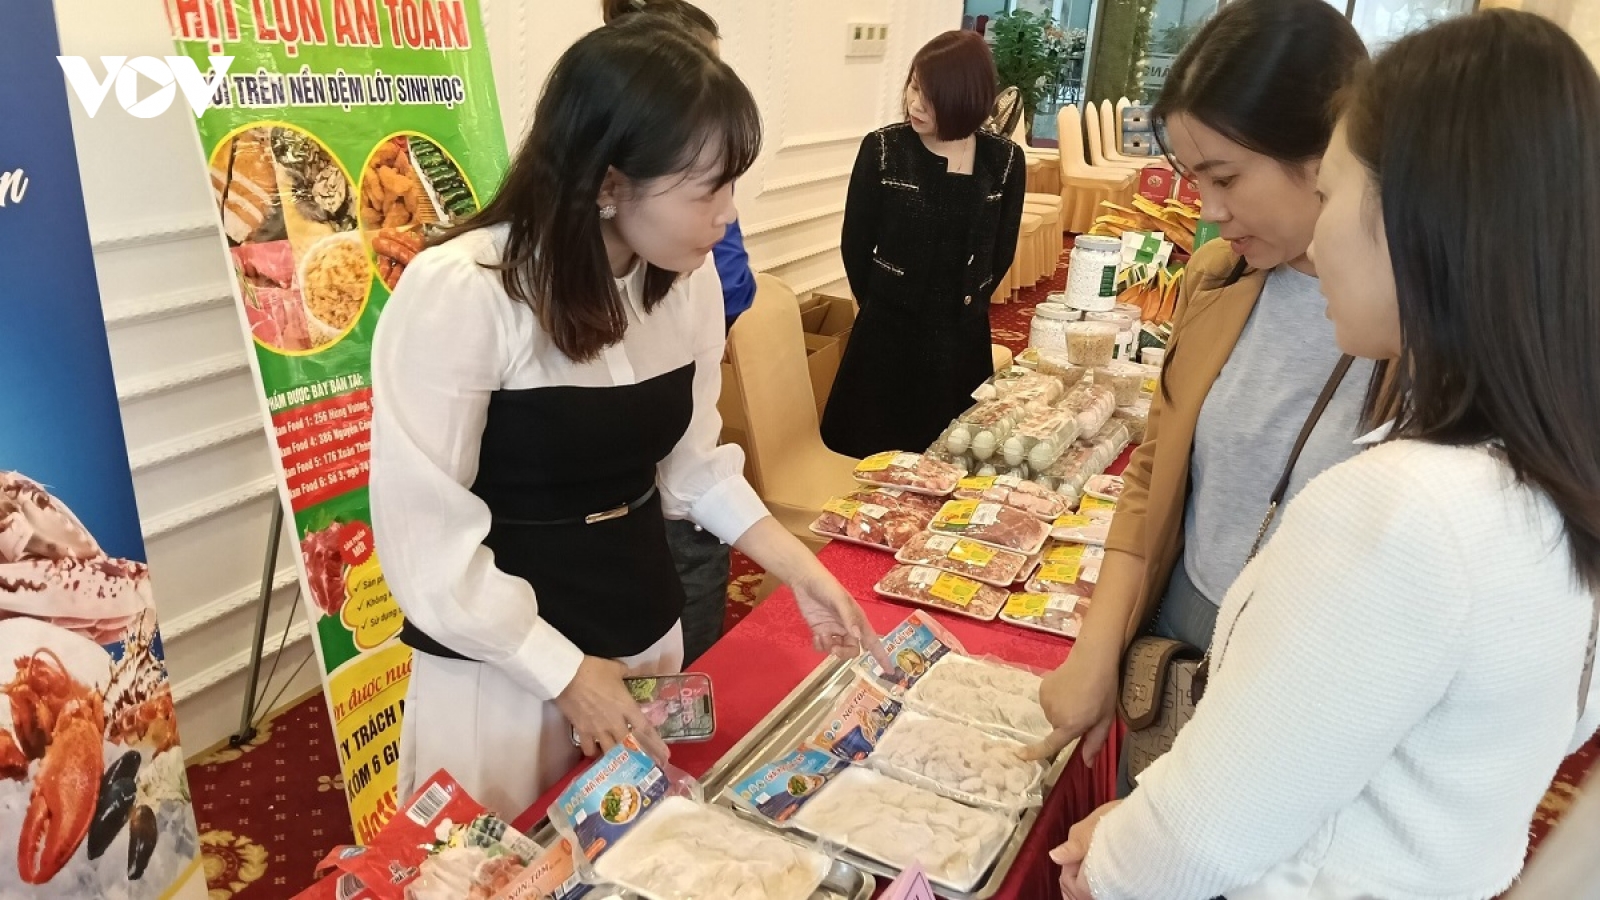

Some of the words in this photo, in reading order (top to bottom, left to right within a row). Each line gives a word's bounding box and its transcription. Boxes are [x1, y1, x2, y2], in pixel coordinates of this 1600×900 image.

[233, 70, 286, 104] TRÊN
[328, 71, 365, 108] ĐỆM
[367, 71, 394, 103] LÓT
[396, 76, 431, 102] SINH
[432, 77, 464, 107] HỌC
[352, 699, 397, 752] TRÁCH
[372, 753, 381, 775] 6
